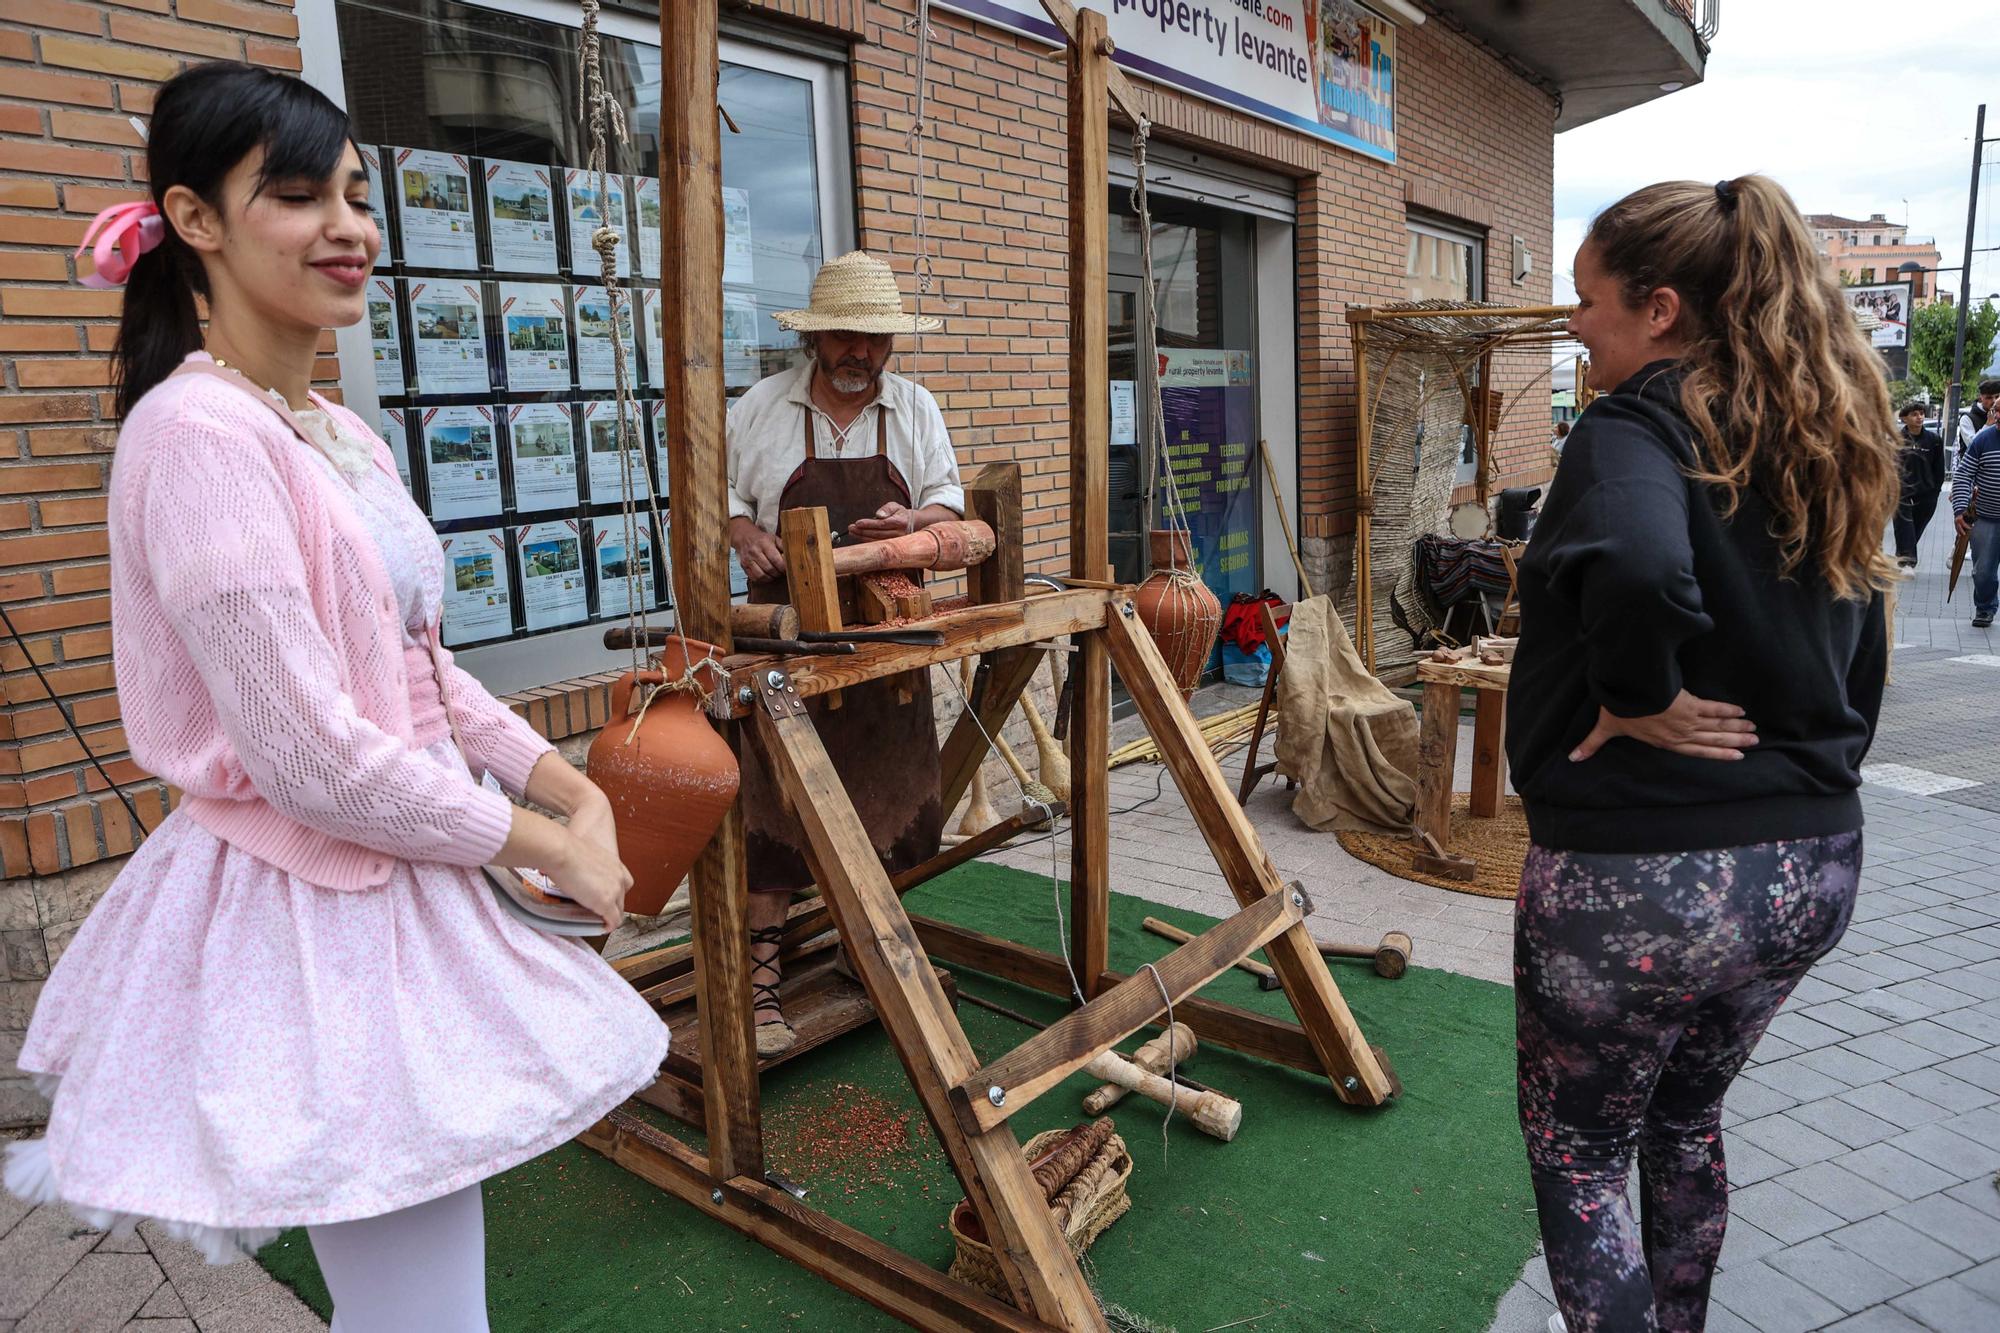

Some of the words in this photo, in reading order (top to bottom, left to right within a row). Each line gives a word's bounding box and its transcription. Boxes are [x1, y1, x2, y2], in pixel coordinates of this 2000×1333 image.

[1235, 16, 1308, 84] levante
[1370, 39, 1391, 95] Tu
[1221, 460, 1245, 475] INTERNET
[1219, 531, 1249, 552] ALARMAS
[1220, 552, 1249, 573] SEGUROS
